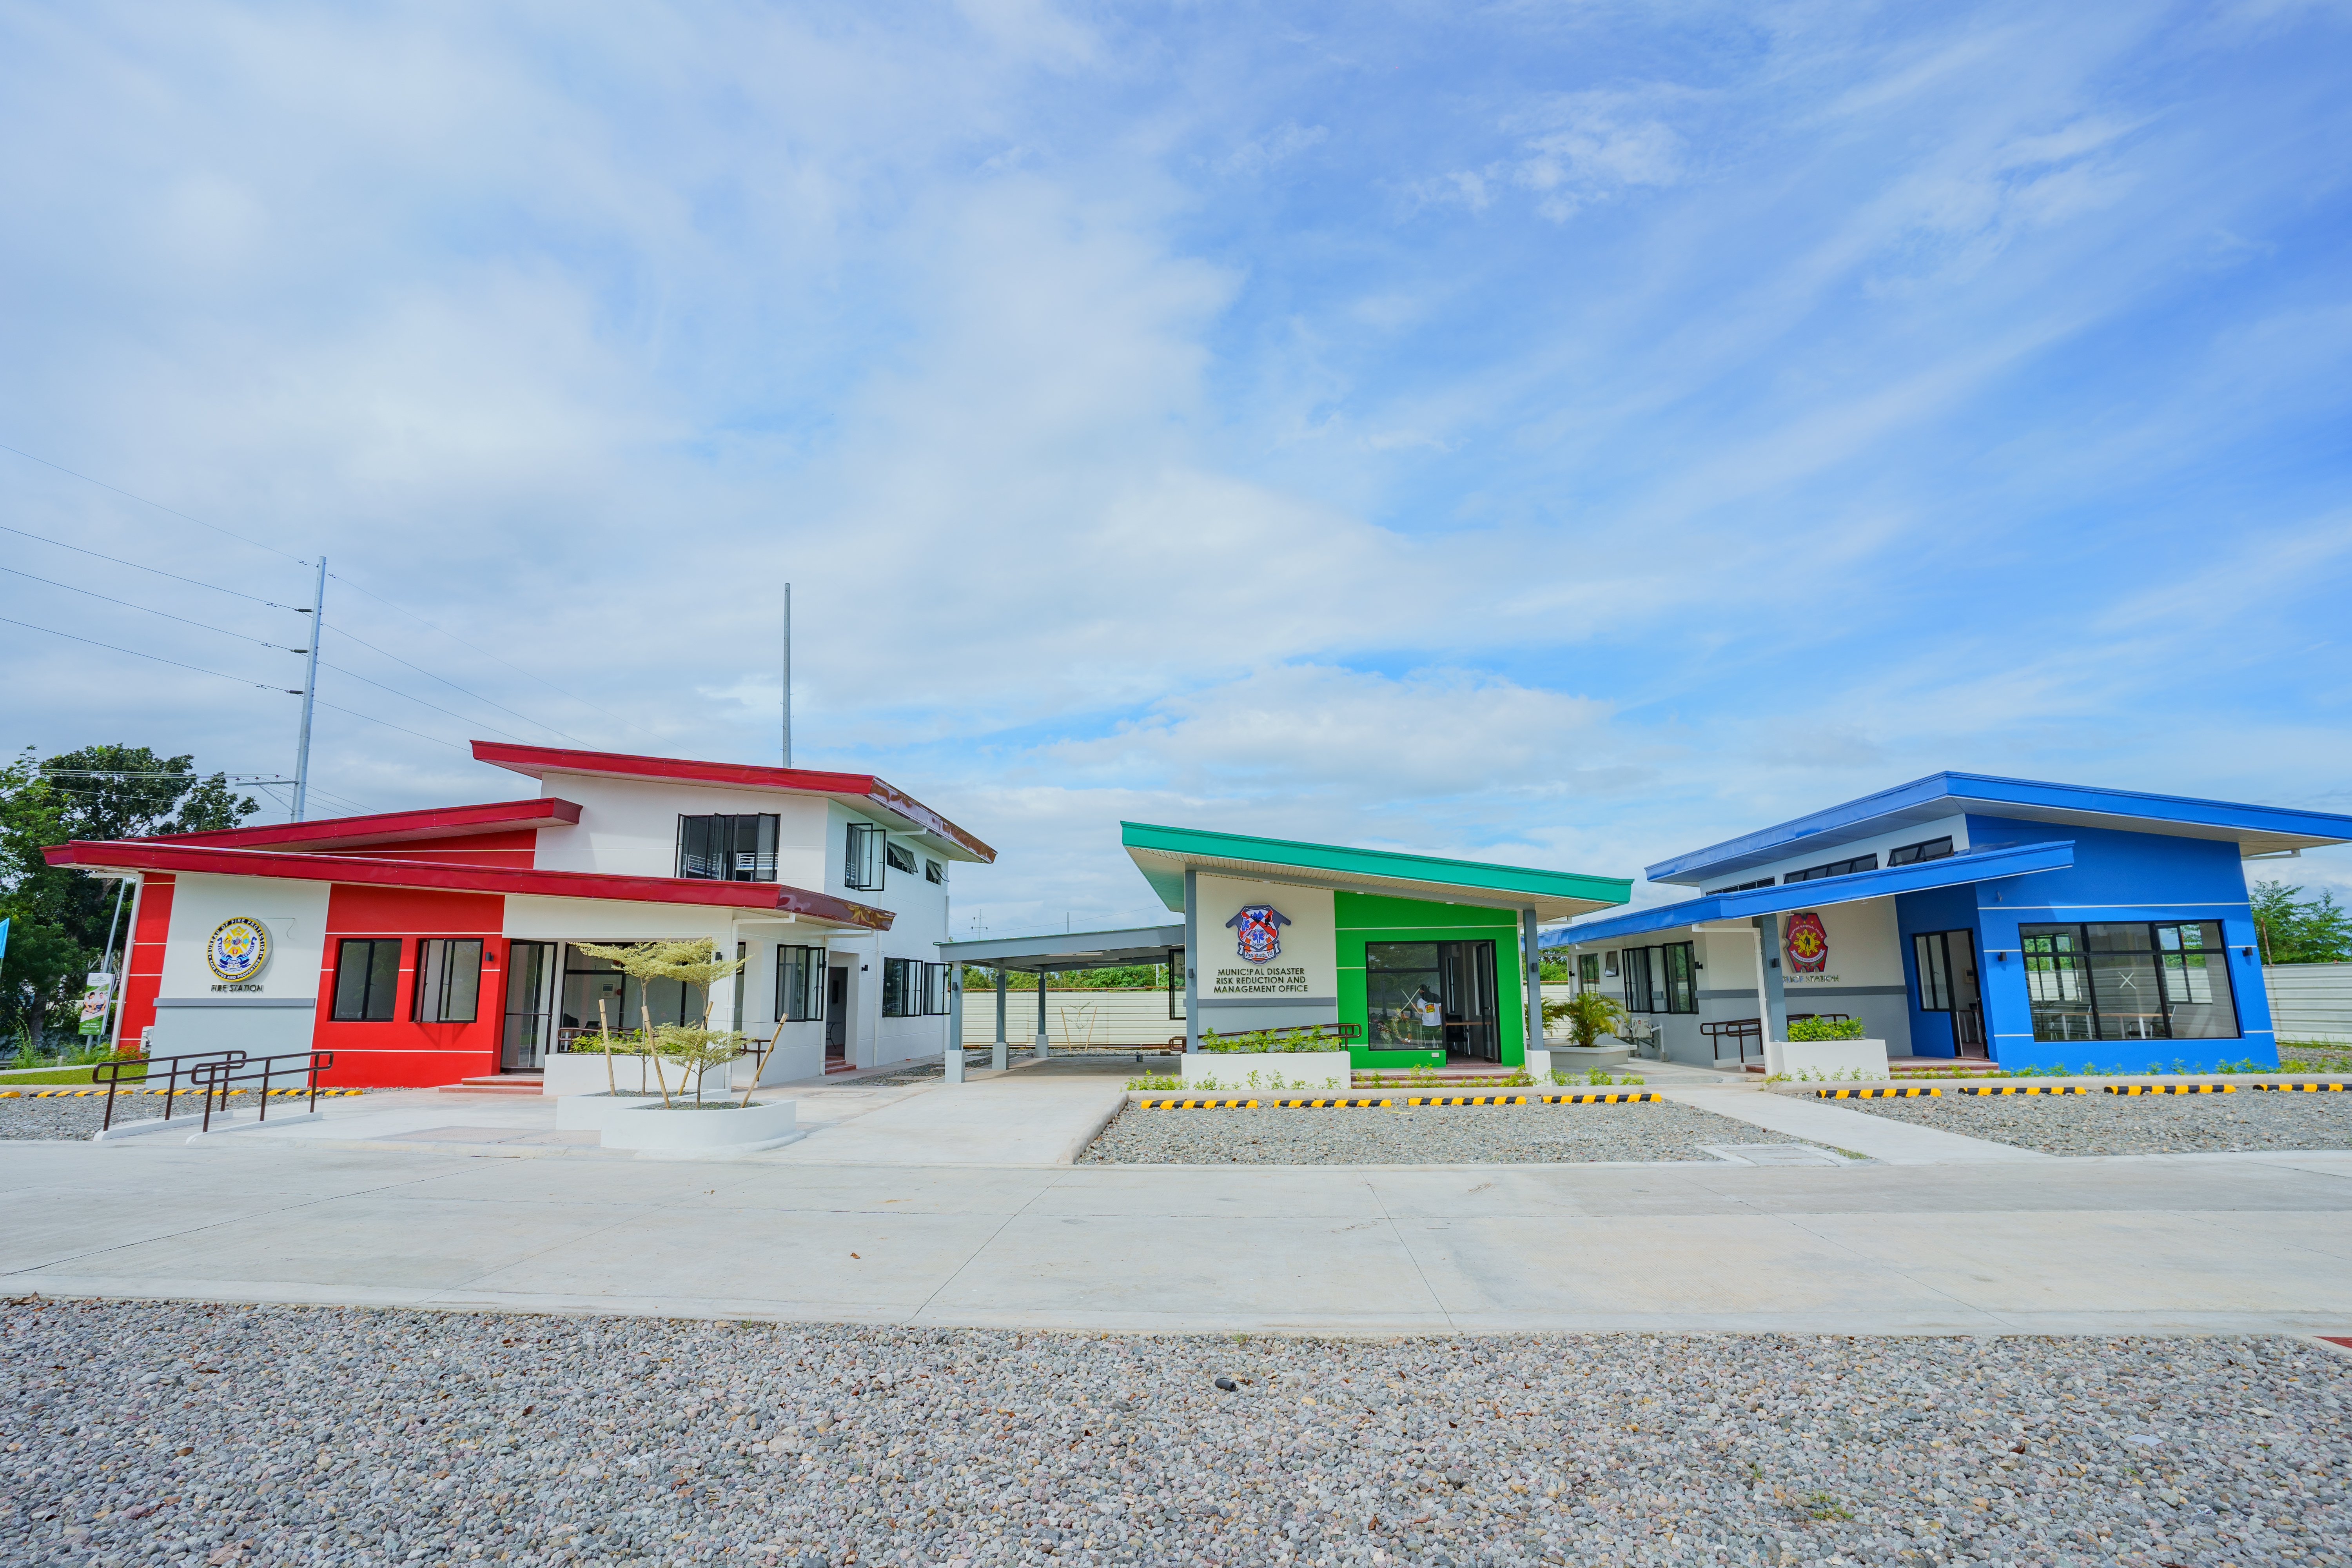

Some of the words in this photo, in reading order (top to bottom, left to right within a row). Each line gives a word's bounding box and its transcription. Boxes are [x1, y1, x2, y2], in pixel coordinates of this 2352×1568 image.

[208, 930, 220, 954] BUREAU
[247, 920, 265, 955] PROTECTION
[1789, 926, 1800, 940] PHILIPPINE
[1815, 928, 1824, 938] POLICE
[215, 969, 226, 978] LIVES
[237, 959, 261, 978] PROPERTIES
